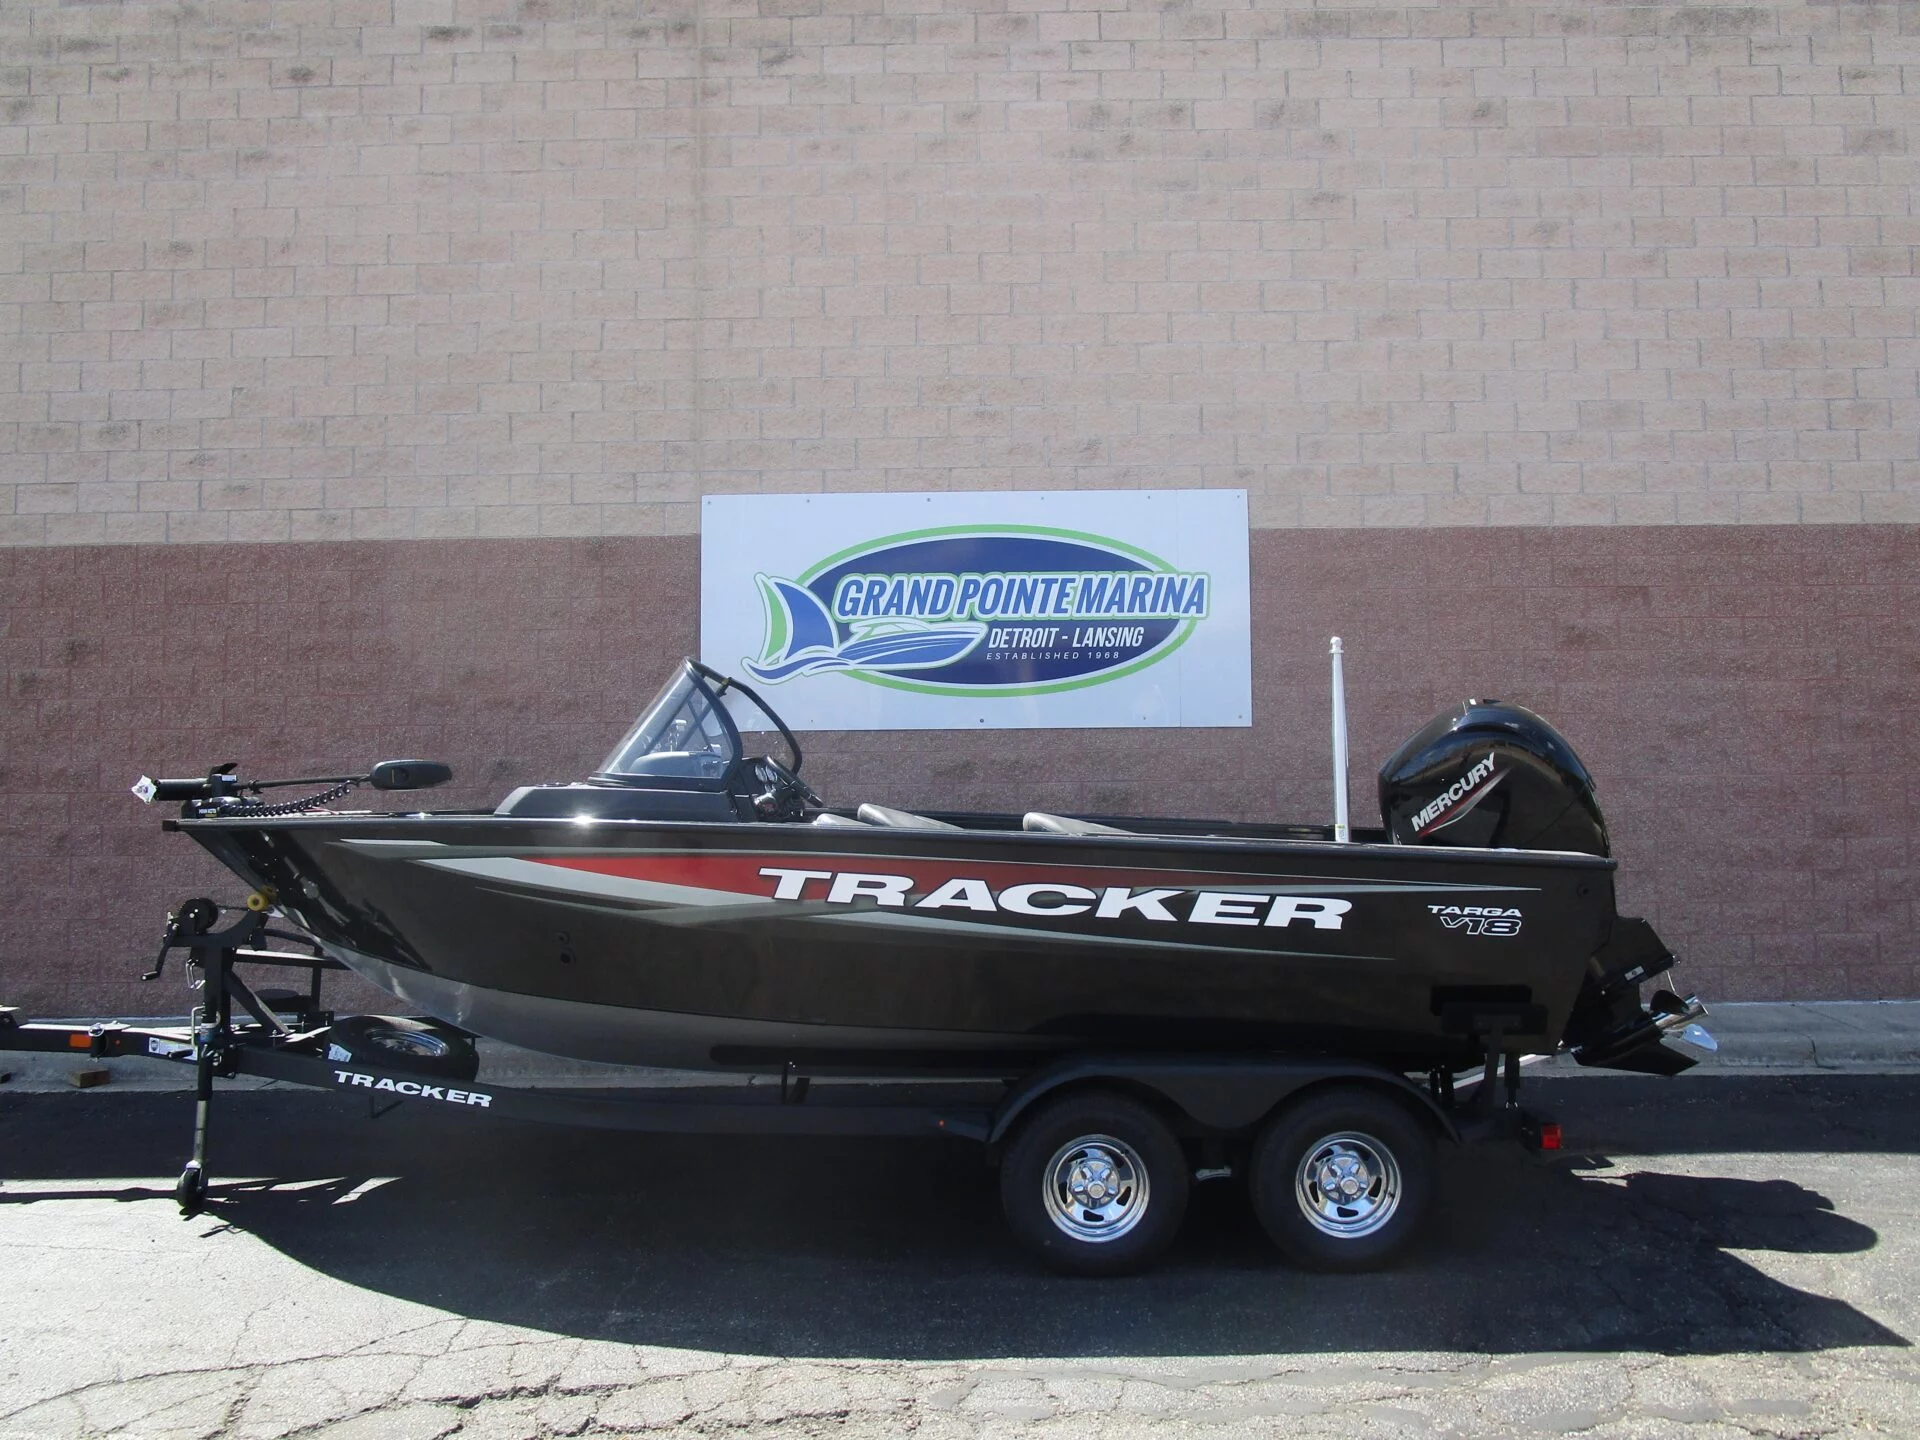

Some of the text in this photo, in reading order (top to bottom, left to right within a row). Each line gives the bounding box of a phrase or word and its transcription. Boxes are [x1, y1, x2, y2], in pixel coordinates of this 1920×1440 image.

[837, 576, 1206, 617] GRAND POINTE MARINA
[988, 627, 1060, 649] DETROIT
[1072, 626, 1145, 648] LANSING
[986, 651, 1120, 661] ESTABLISHED 1968
[1410, 751, 1497, 832] MERCURY
[758, 867, 1353, 931] TRACKER
[1427, 904, 1523, 917] TARGA
[1439, 916, 1523, 937] V18
[334, 1070, 493, 1108] TRACKER
